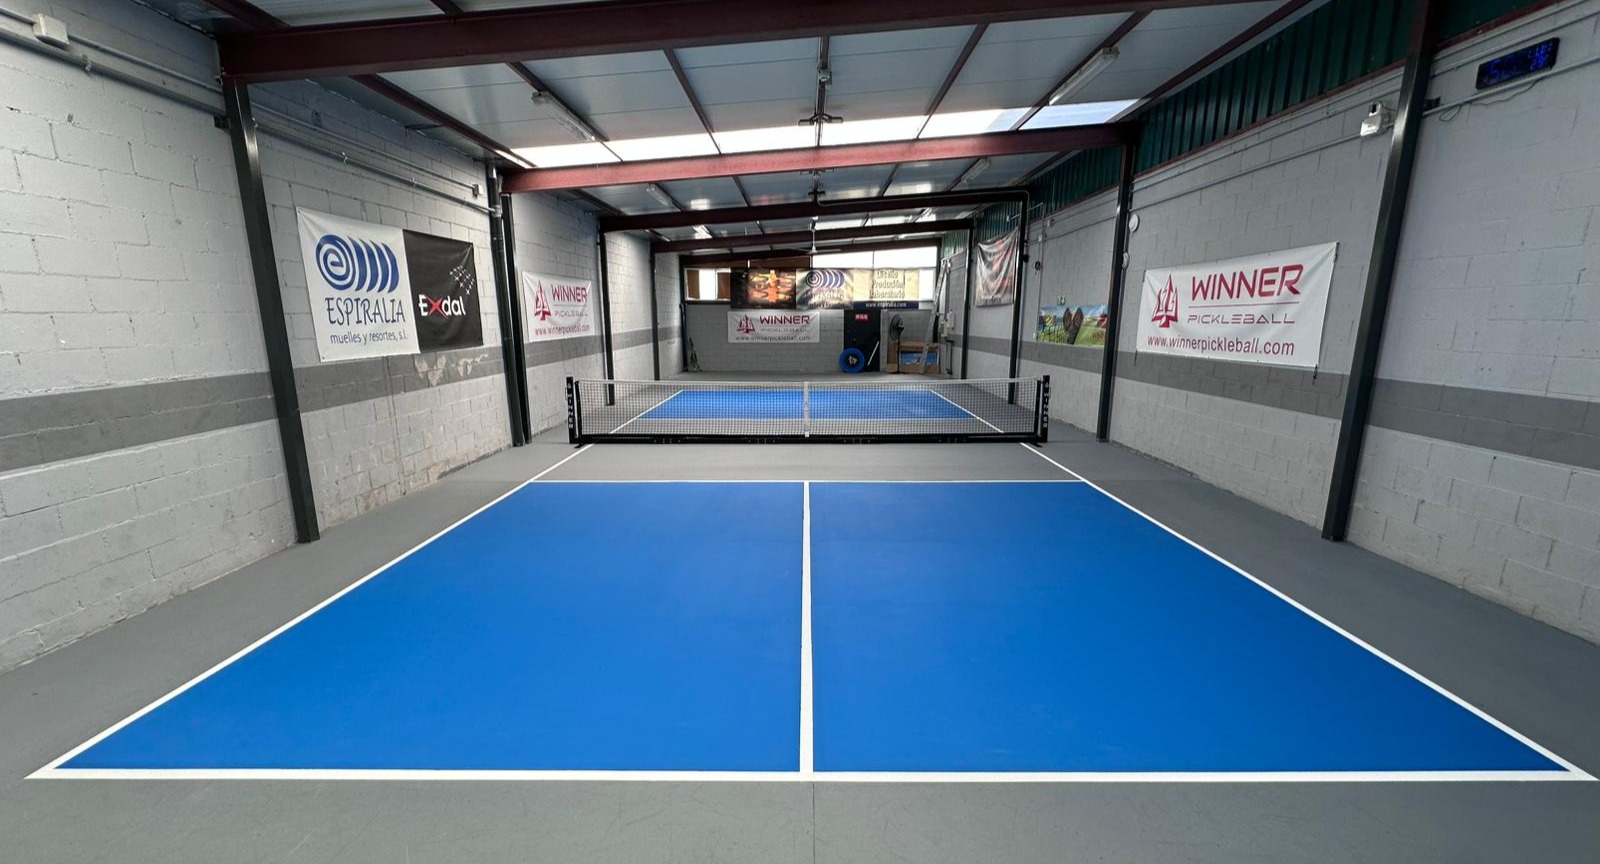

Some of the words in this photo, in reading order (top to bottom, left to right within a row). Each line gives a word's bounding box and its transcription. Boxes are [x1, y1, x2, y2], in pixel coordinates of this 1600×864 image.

[551, 283, 588, 302] WINNER
[1191, 263, 1304, 302] WINNER
[325, 297, 405, 326] ESPIRALIA
[418, 293, 466, 319] Exdal
[759, 315, 810, 325] WINNER
[1187, 313, 1295, 324] PICKLEBALL
[330, 331, 362, 344] muelles
[363, 333, 368, 345] y
[1147, 335, 1295, 356] www.winnerpickleball.com
